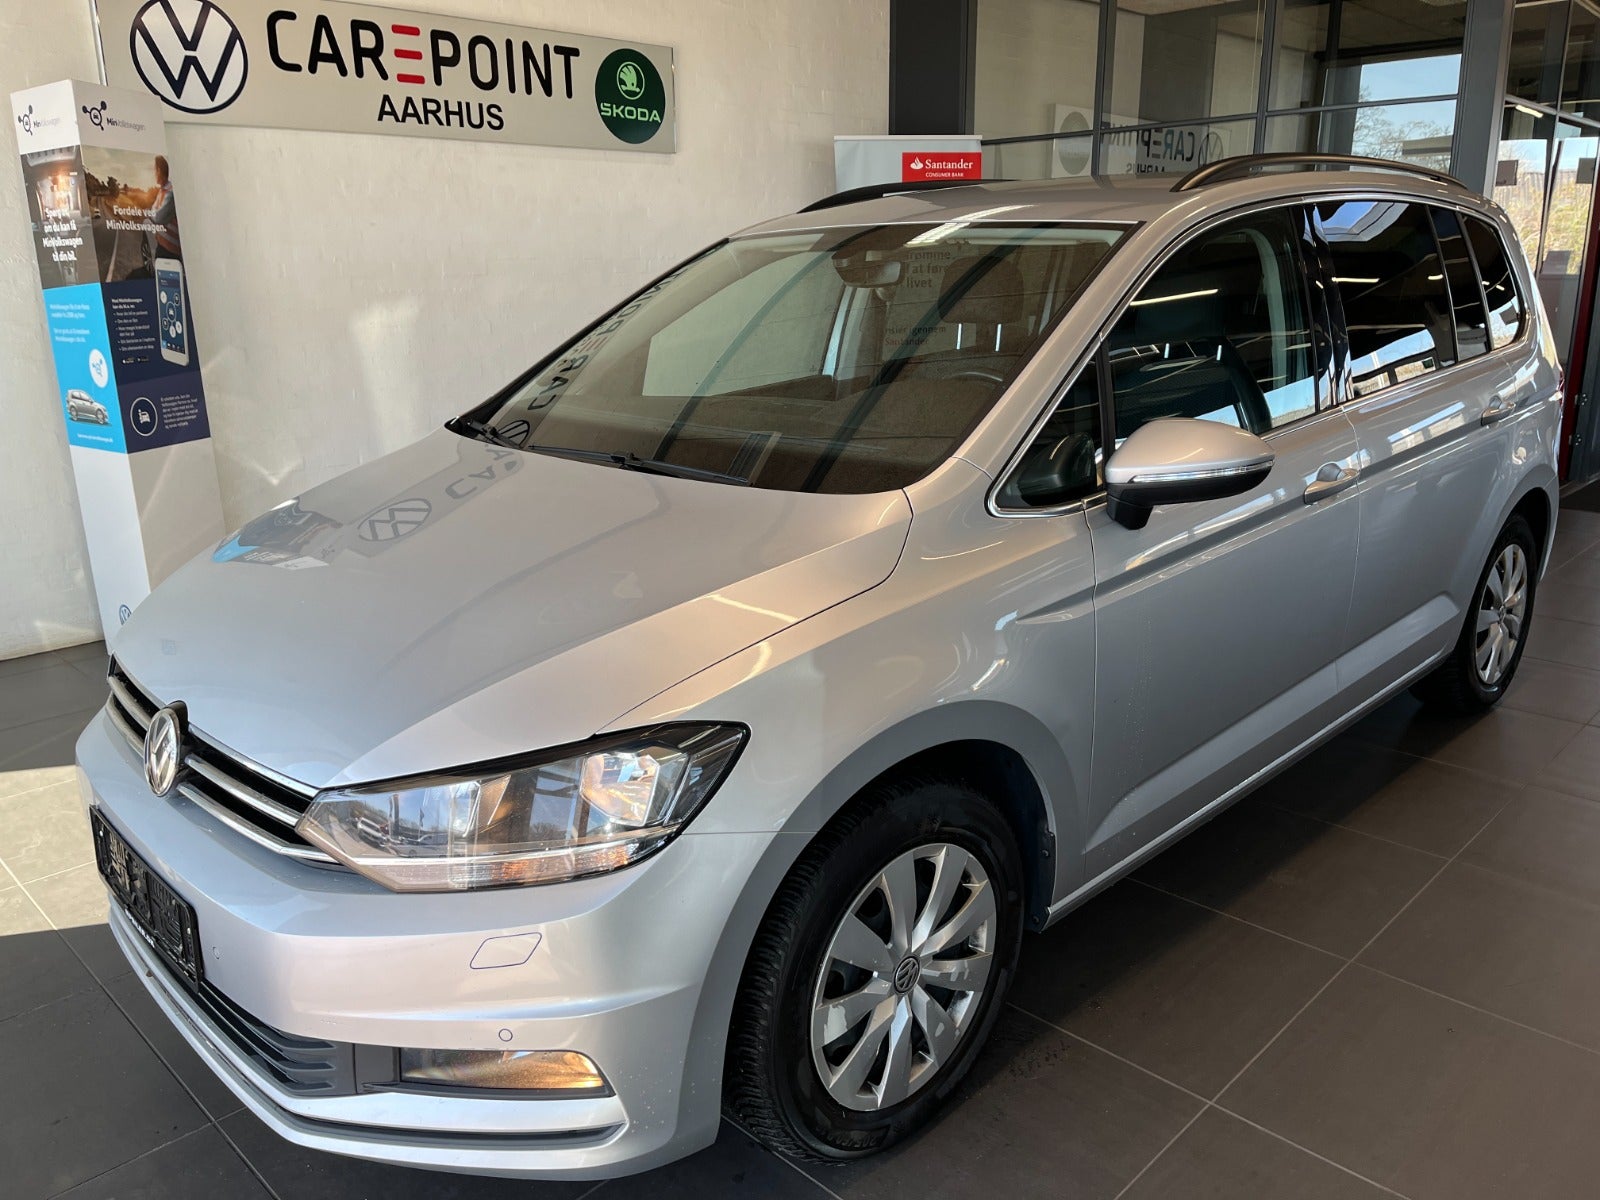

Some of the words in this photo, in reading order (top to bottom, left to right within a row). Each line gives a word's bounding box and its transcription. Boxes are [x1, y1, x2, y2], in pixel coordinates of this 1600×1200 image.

[267, 10, 580, 100] CAREPOINT
[377, 94, 504, 131] AARHUS
[925, 158, 973, 169] Santander
[113, 205, 142, 217] Fordele
